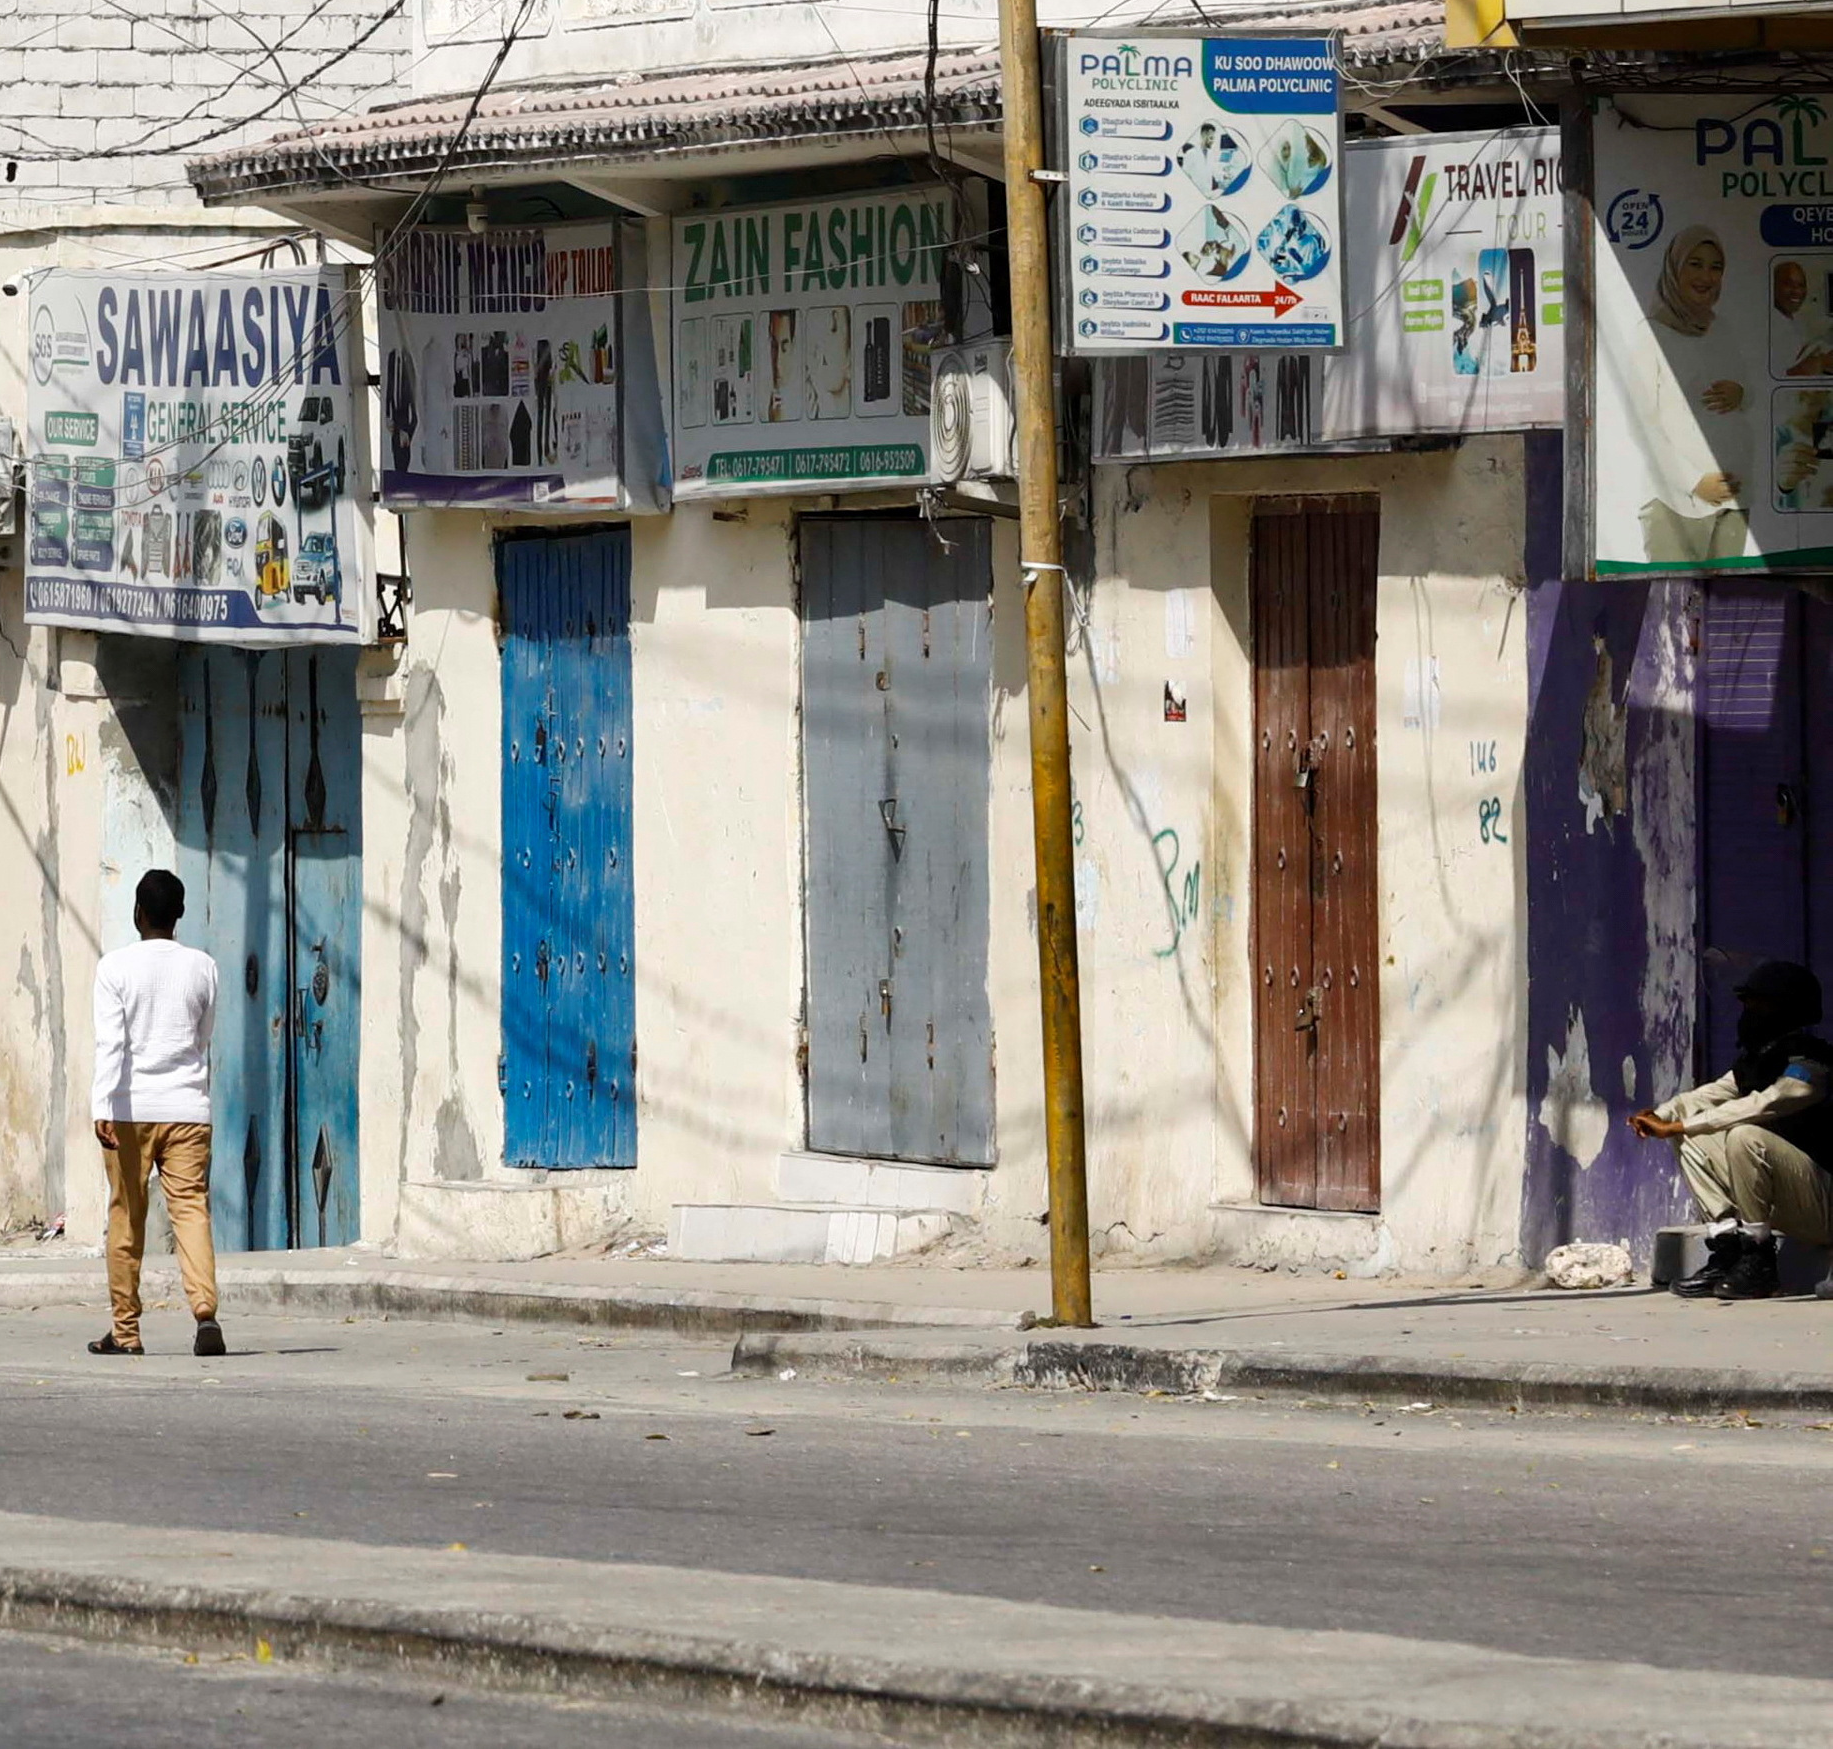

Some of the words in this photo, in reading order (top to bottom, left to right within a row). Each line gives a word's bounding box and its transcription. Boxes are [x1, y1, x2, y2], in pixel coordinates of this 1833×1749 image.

[1081, 53, 1193, 78] PALMA
[1214, 55, 1232, 71] KU
[1234, 55, 1264, 71] SOO
[1265, 56, 1334, 72] DHAWOOW
[1092, 77, 1178, 91] POLYCLINIC
[1213, 77, 1256, 93] PALMA
[1259, 78, 1333, 93] POLYCLINIC
[1083, 98, 1131, 109] ADEEGYADA
[1444, 160, 1527, 202] TRAVEL
[1496, 211, 1546, 241] TOUR
[1621, 212, 1649, 230] 24
[684, 215, 770, 303] ZAIN
[784, 202, 945, 293] FASHION
[467, 230, 546, 314] MEXICO
[571, 246, 613, 299] TAILOR
[1191, 293, 1215, 303] RAAC
[1217, 293, 1261, 304] FALAARTA
[34, 333, 52, 358] SGS
[96, 283, 342, 388] SAWAASIYA
[47, 418, 63, 439] OUR
[63, 419, 96, 441] SERVICE
[147, 400, 216, 444] GENERAL
[220, 400, 286, 444] SERVICE
